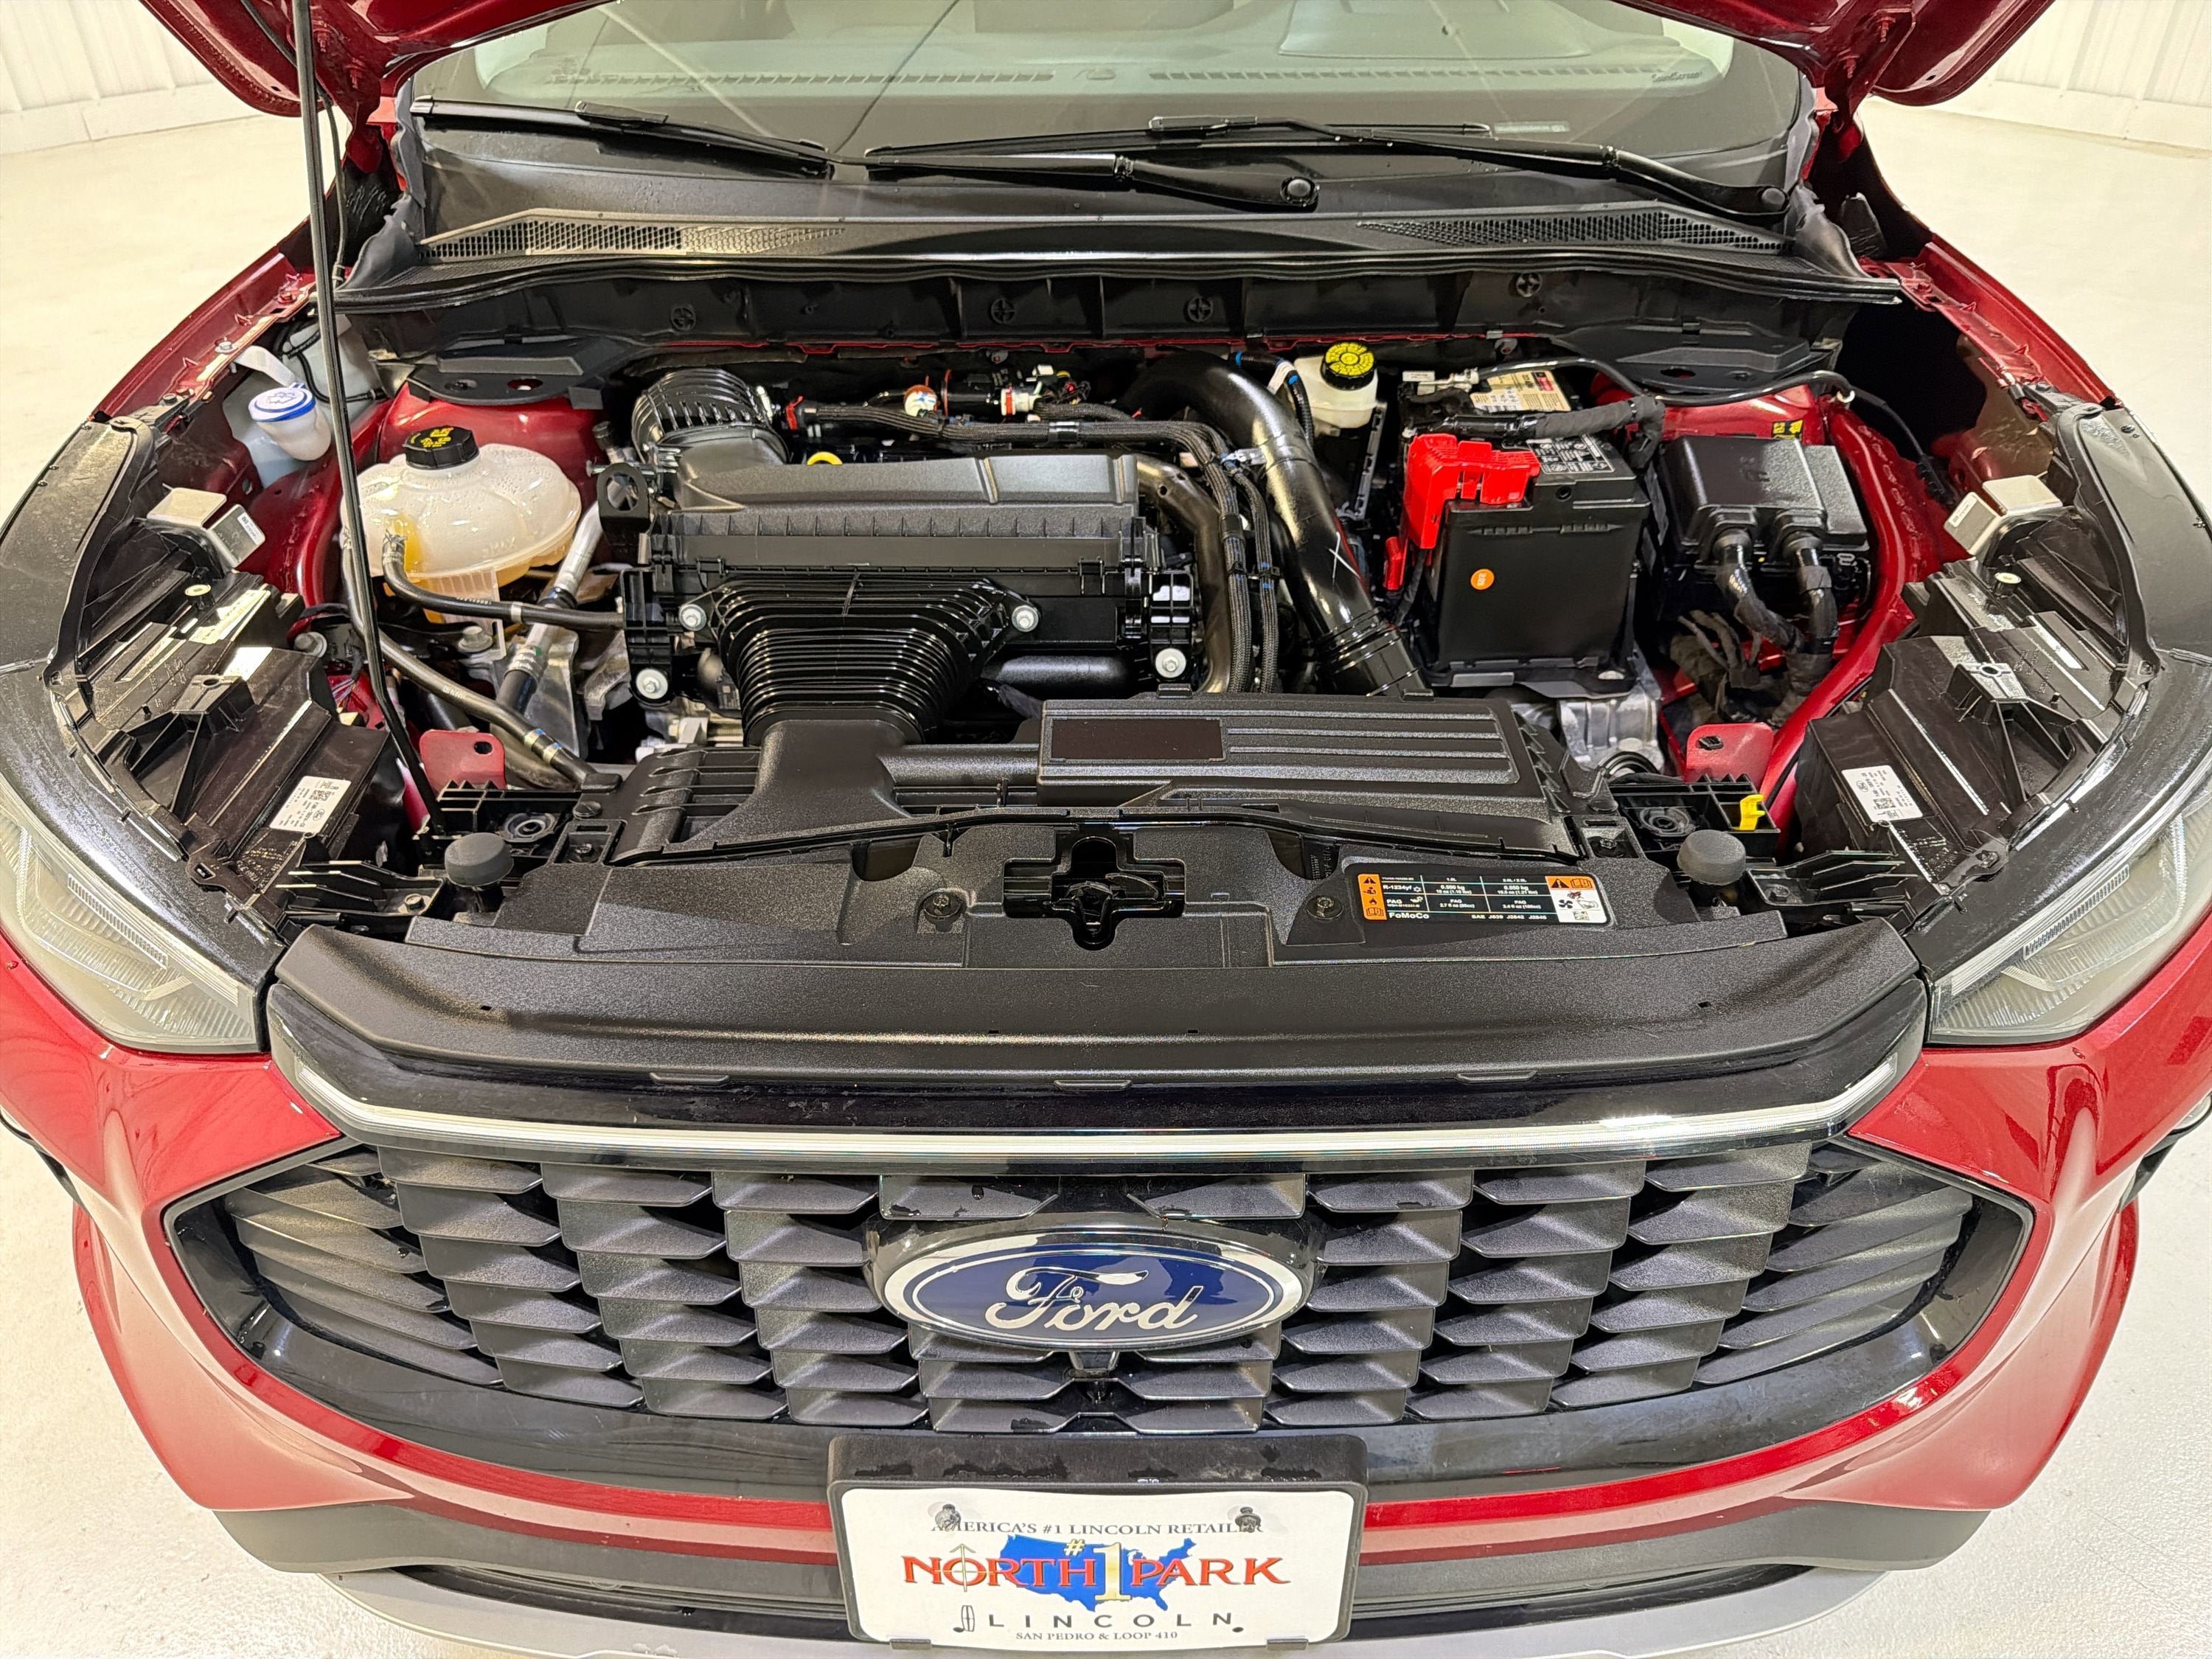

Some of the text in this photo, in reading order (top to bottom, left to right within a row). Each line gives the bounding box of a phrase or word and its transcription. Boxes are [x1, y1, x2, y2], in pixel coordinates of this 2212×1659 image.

[984, 1266, 1203, 1331] Ford
[931, 1520, 1264, 1535] ERICA'S #1 LINCOLN RETAIL
[901, 1555, 1097, 1588] NORTH
[1130, 1557, 1292, 1587] PARK
[989, 1613, 1232, 1628] LINCOLN
[1015, 1631, 1178, 1640] SAN PEDRO & LOOP 410
